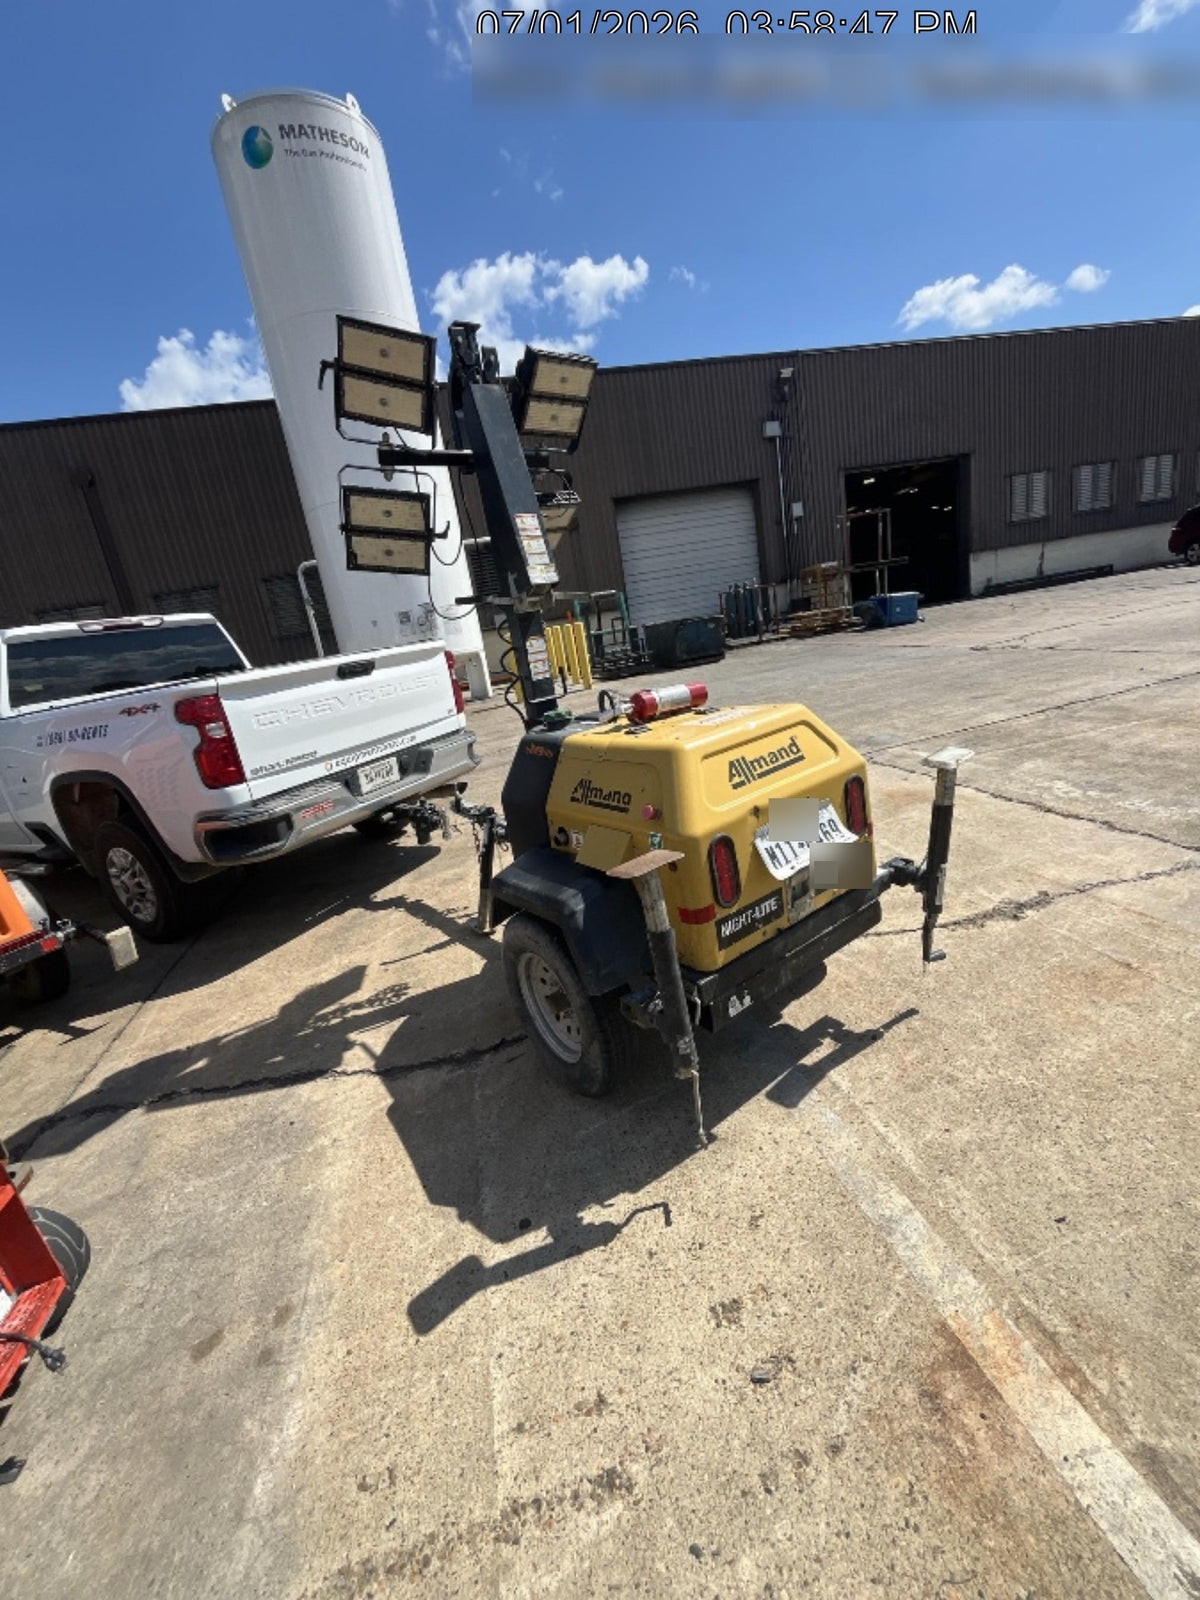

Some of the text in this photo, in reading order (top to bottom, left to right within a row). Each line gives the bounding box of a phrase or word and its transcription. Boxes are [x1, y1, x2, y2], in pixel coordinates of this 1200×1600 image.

[278, 124, 370, 159] MATHESON
[251, 672, 440, 731] CHEVROLET
[728, 736, 803, 785] Allmand
[721, 896, 778, 938] NIGHT-LITE
